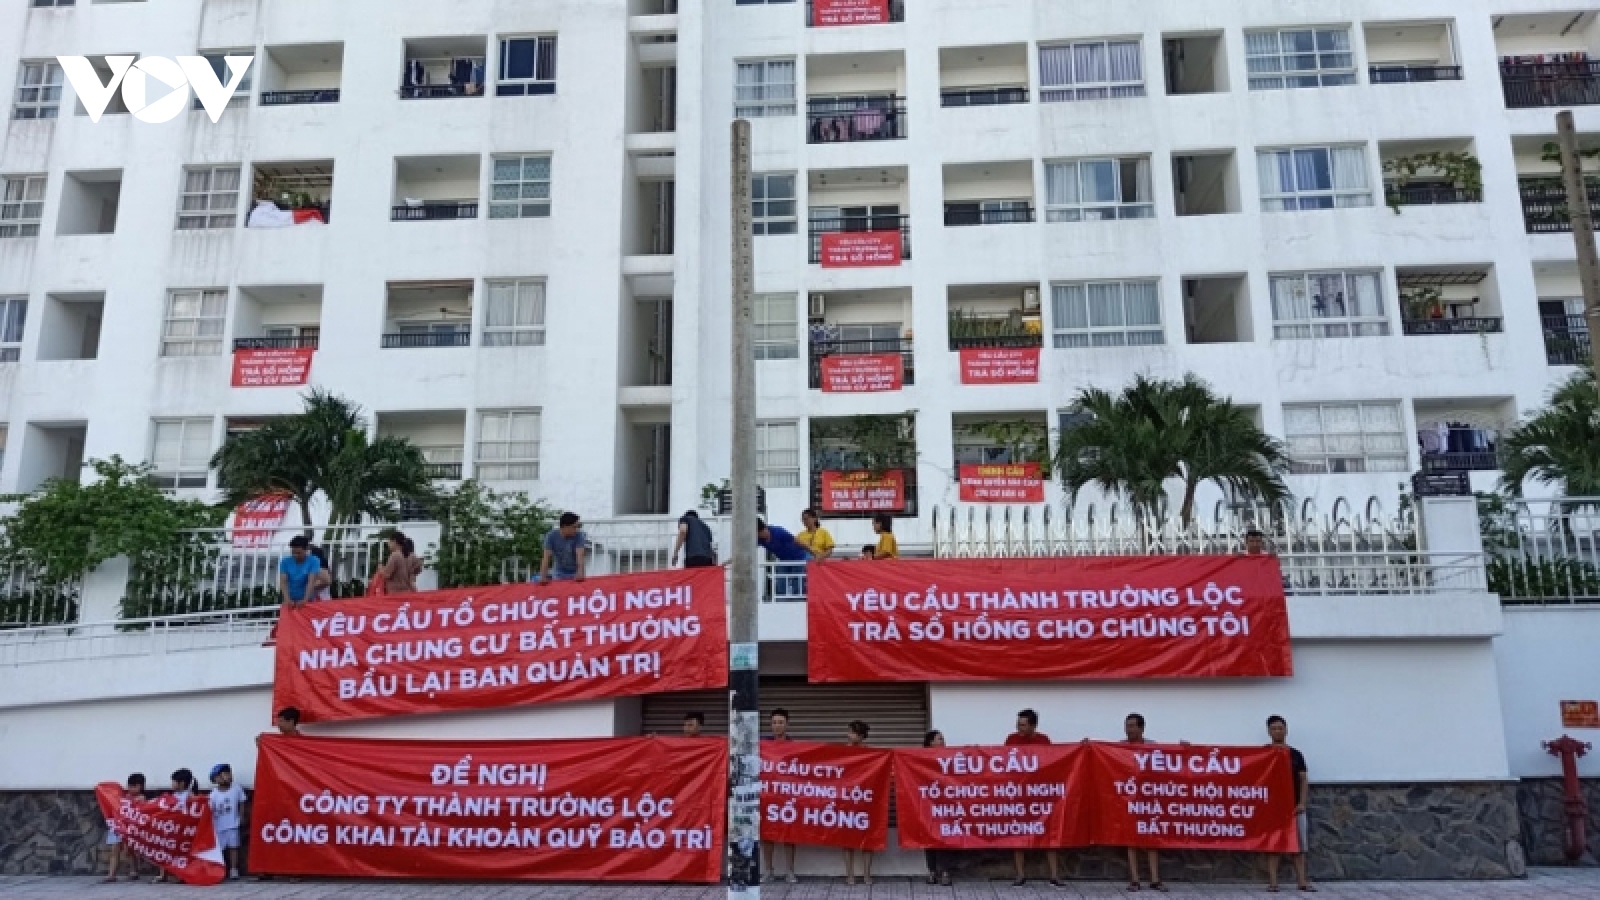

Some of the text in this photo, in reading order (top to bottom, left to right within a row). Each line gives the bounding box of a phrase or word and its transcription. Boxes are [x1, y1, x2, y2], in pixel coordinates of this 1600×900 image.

[846, 582, 1242, 610] YÊU CẦU THÀNH TRƯỜNG LỘC
[312, 586, 690, 638] YÊU CẦU TỔ CHỨC HỘI NGHỊ
[848, 612, 1248, 640] TRẢ SỔ HỒNG CHO CHÚNG TÔI
[300, 612, 700, 670] NHÀ CHUNG CƯ BẤT THƯỜNG
[340, 652, 660, 698] BẦU LẠI BAN QUẢN TRỊ
[431, 754, 546, 790] ĐỀ NGHỊ
[776, 758, 810, 776] CẦU
[814, 764, 844, 778] CTY
[936, 748, 1038, 774] YÊU CẦU
[1134, 748, 1240, 774] YÊU CẦU
[772, 782, 836, 798] TRƯỜNG
[842, 786, 872, 804] LỘC
[918, 781, 1064, 798] TỔ CHỨC HỘI NGHỊ
[1114, 776, 1268, 802] TỔ CHỨC HỘI NGHỊ
[300, 790, 674, 822] CÔNG TY THÀNH TRƯỜNG LỘC
[768, 798, 796, 822] SỔ
[804, 802, 868, 830] HỒNG
[932, 802, 1052, 816] NHÀ CHUNG CƯ
[1128, 800, 1254, 818] NHÀ CHUNG CƯ
[262, 820, 711, 848] CÔNG KHAI TÀI KHOẢN QUỸ BẢO TRÌ
[940, 818, 1044, 836] BẤT THƯỜNG
[1138, 816, 1244, 836] BẤT THƯỜNG
